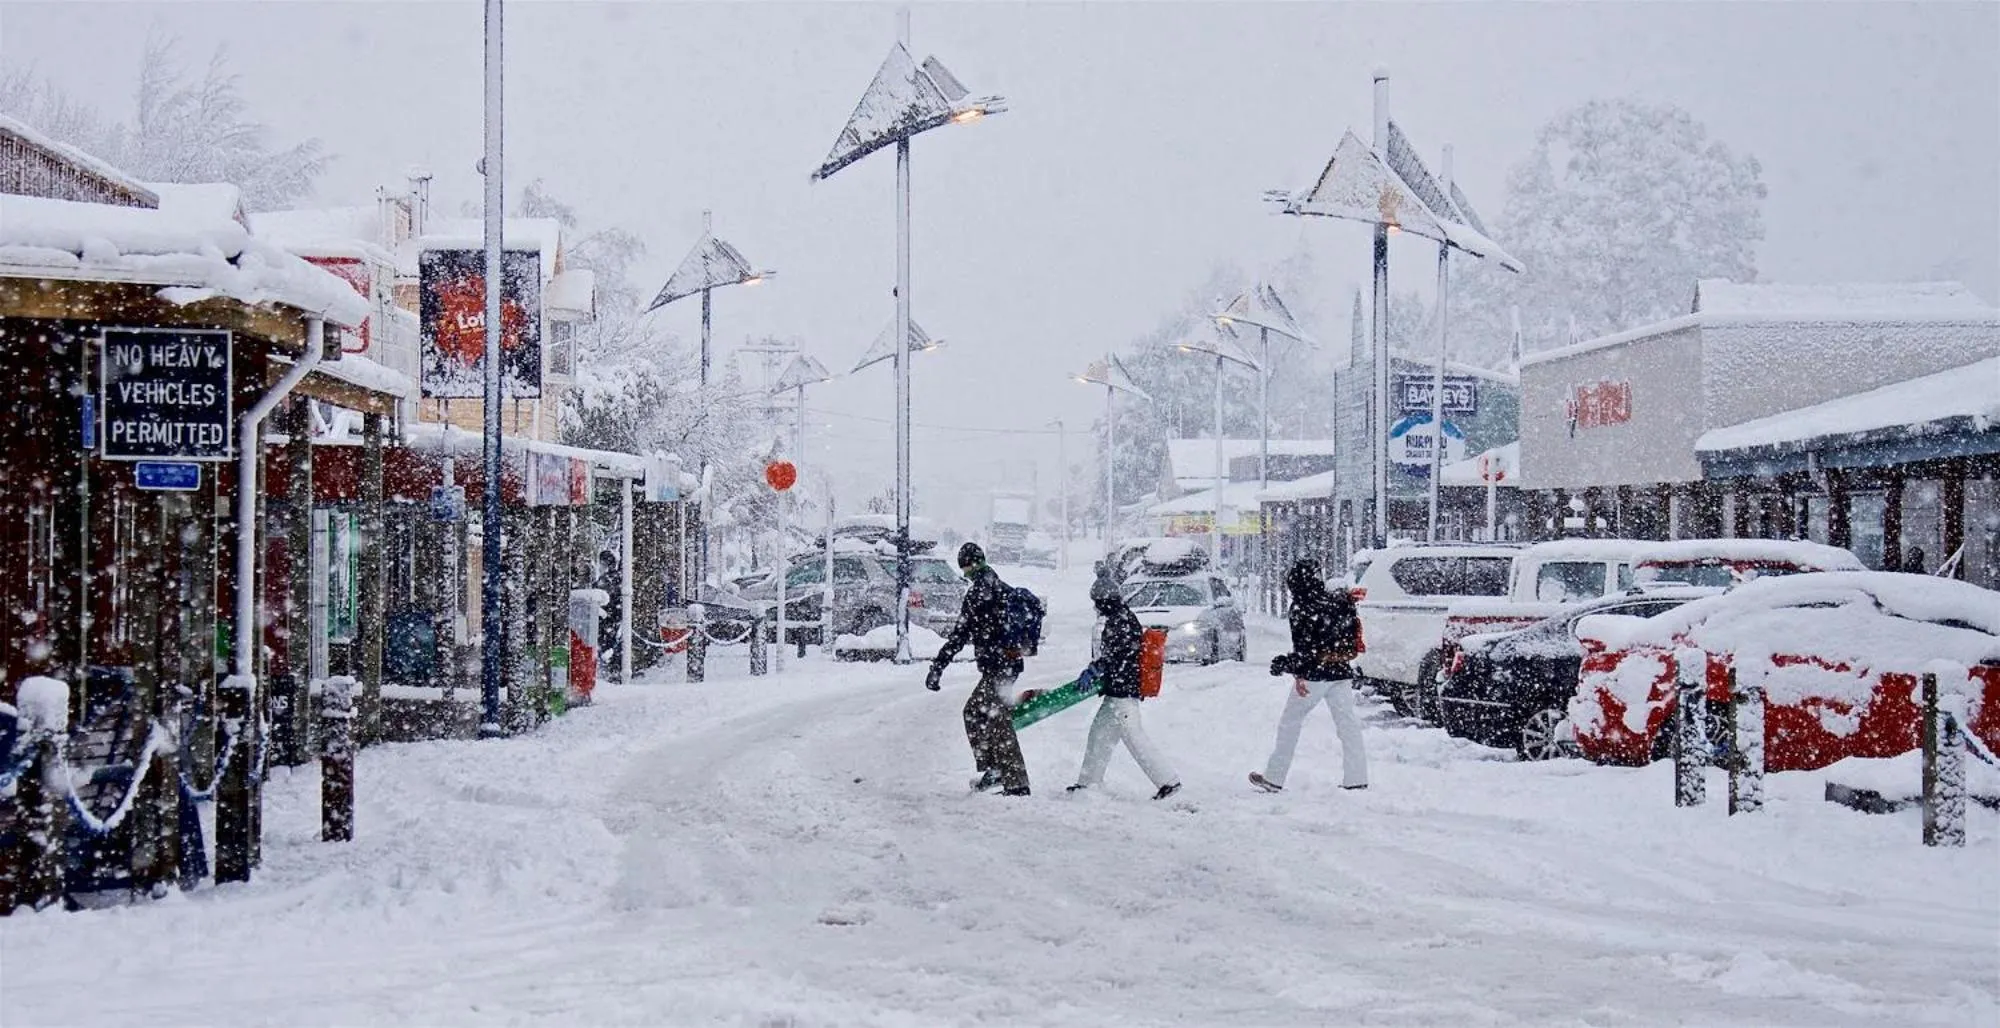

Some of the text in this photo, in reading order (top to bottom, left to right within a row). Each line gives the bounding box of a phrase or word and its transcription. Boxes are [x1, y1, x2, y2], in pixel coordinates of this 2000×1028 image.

[115, 344, 216, 368] NO HEAVY
[119, 382, 215, 405] VEHICLES
[1408, 386, 1470, 405] BAYEYS
[112, 421, 223, 445] PERMITTED
